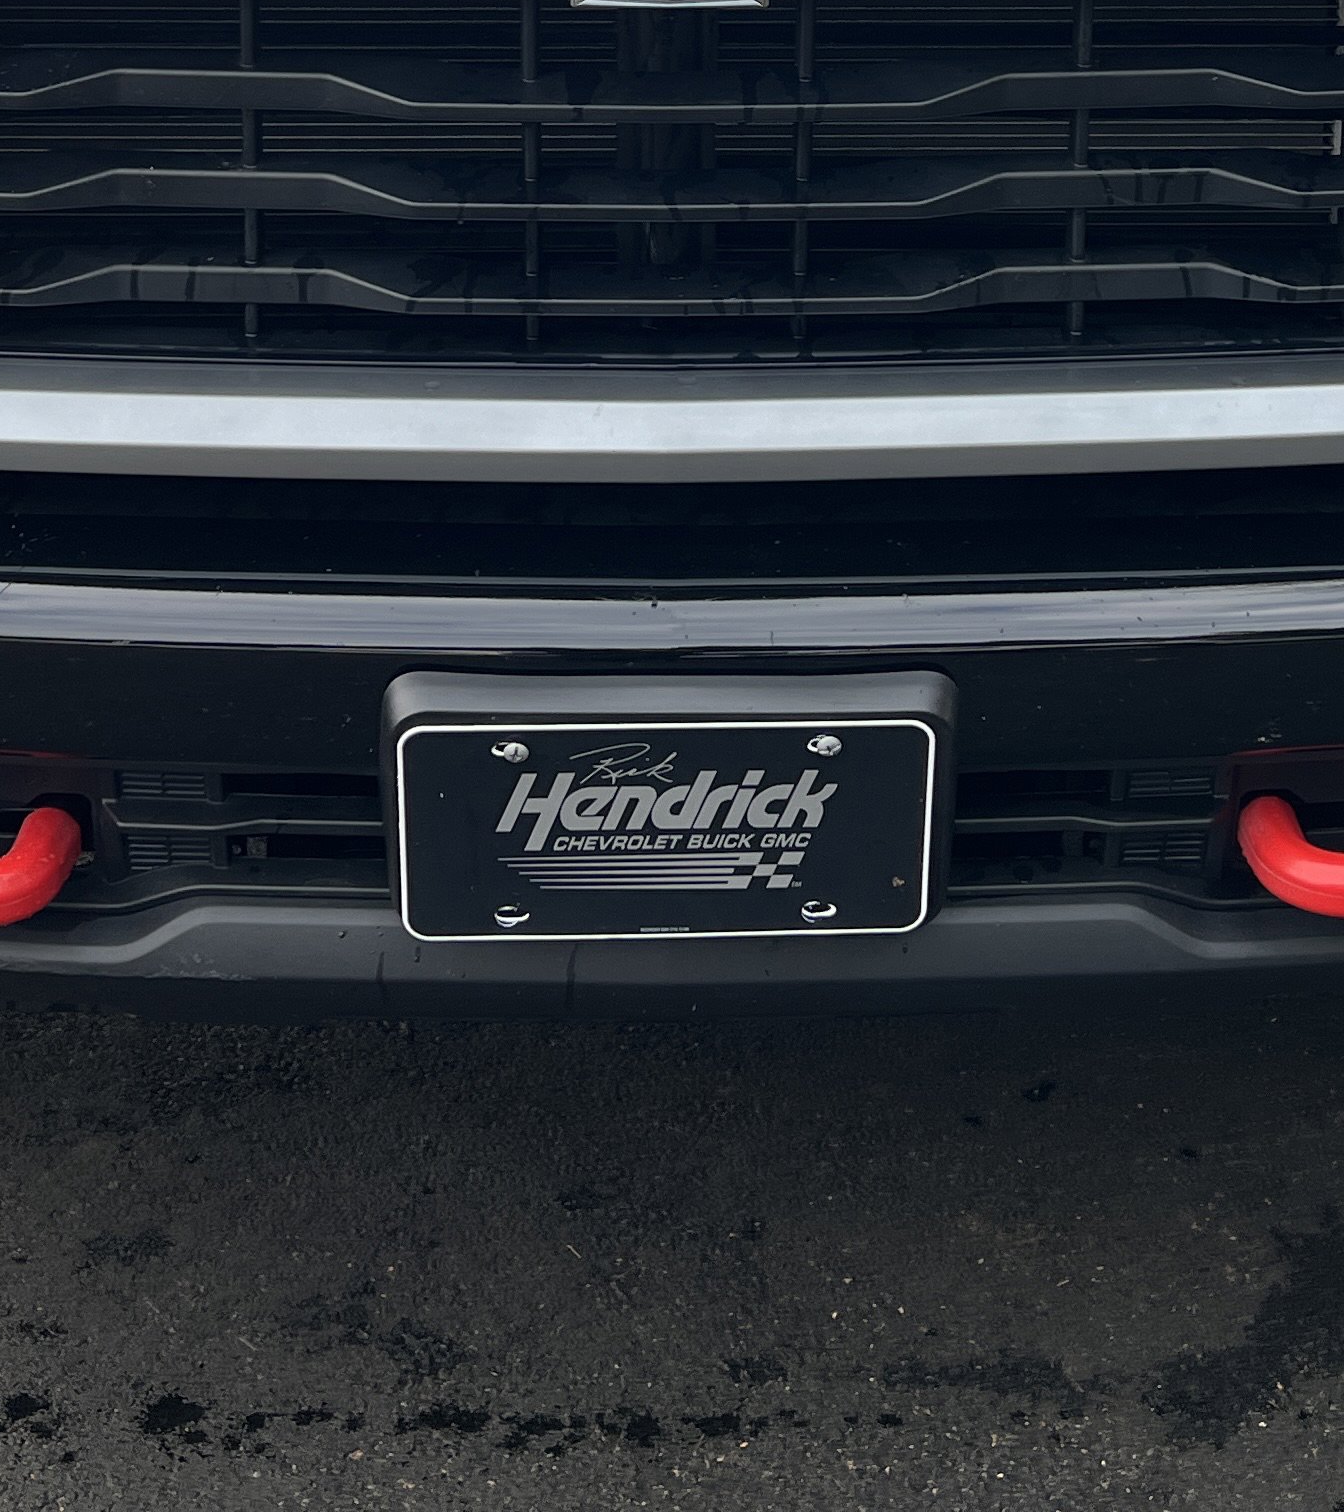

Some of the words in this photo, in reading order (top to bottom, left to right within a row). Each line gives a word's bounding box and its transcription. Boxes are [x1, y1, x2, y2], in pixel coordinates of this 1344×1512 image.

[495, 769, 839, 852] Hendrick
[553, 834, 684, 852] CHEVROLET
[686, 833, 756, 850] BUICK
[759, 832, 812, 849] GMC
